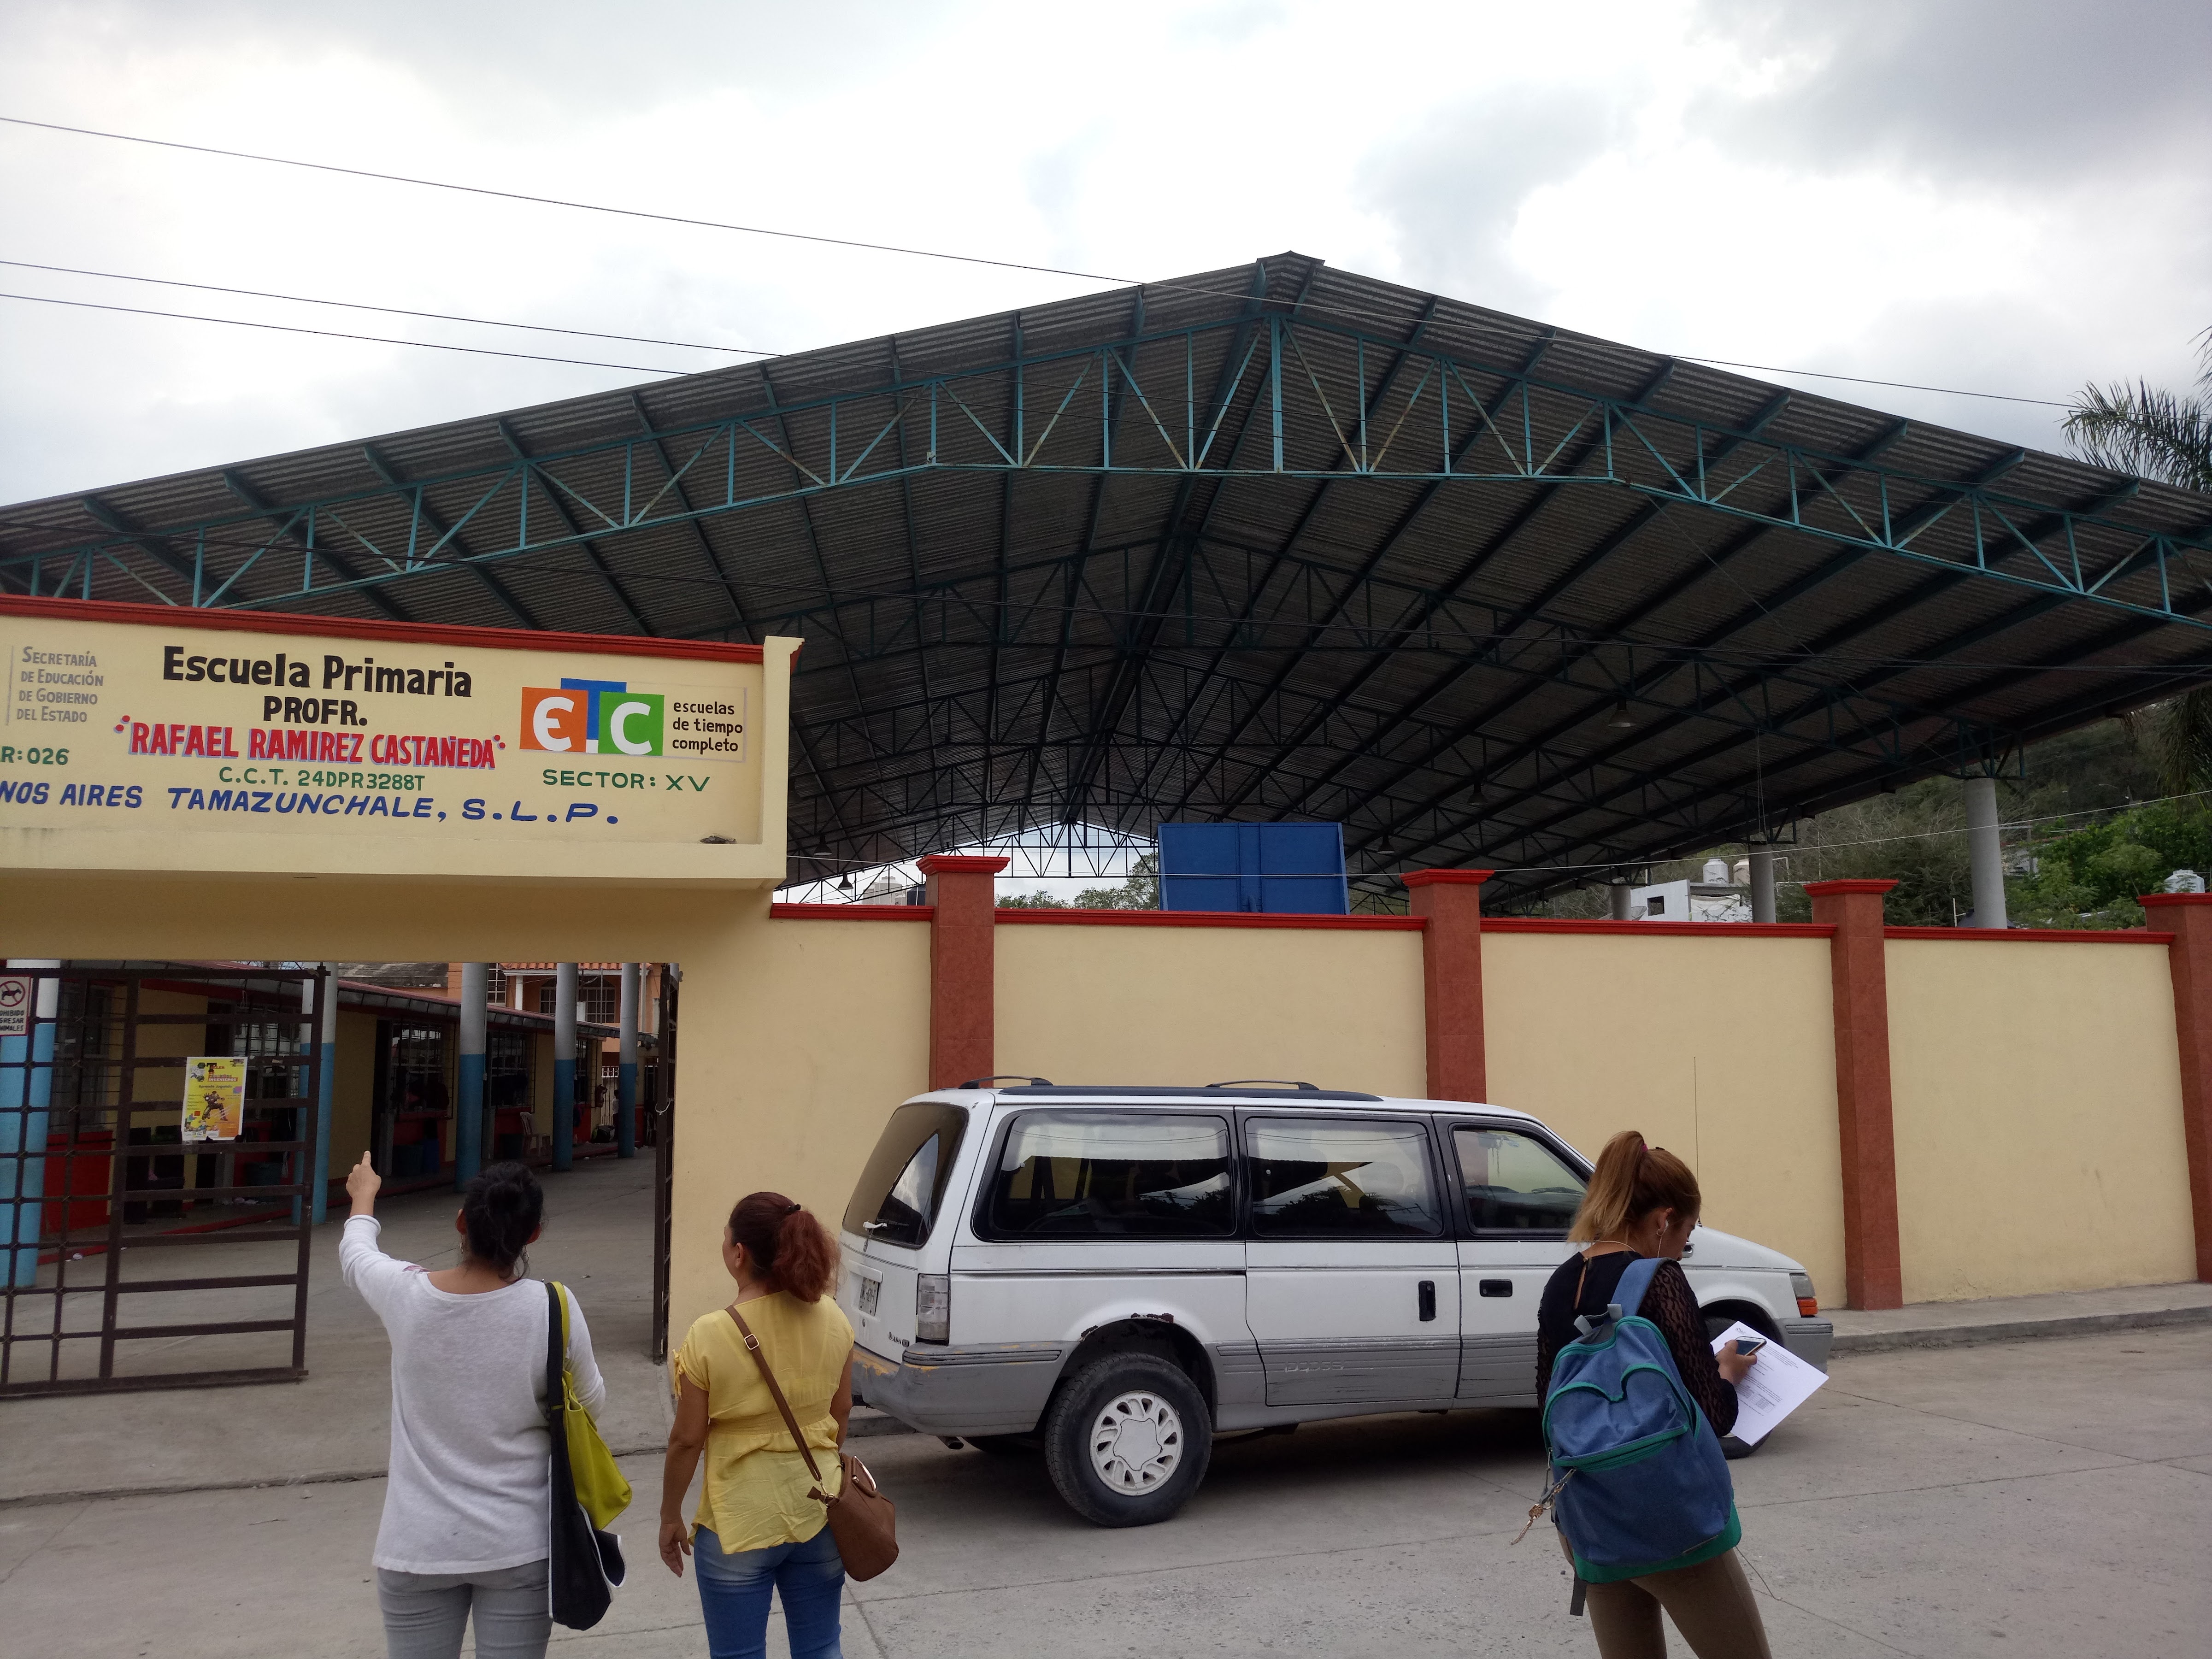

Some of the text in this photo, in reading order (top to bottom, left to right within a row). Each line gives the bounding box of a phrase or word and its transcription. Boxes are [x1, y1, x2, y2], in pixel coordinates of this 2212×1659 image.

[22, 647, 96, 667] SECRETARÍA
[21, 669, 103, 686] DE EDUCACIÓN
[164, 646, 471, 698] Escuela Primaria
[19, 688, 97, 705] DE GOBIERNO
[17, 706, 87, 722] DEL ESTADO
[264, 696, 367, 726] PROFR.
[673, 701, 735, 715] escuelas
[673, 717, 743, 734] de tiempo
[248, 728, 365, 763] RAMIREZ
[672, 737, 738, 754] completo
[1, 746, 70, 765] R:026
[219, 767, 425, 790] C.C.T. 24DPR3288T
[543, 769, 710, 791] SECTOR: XV
[0, 781, 618, 824] NOS AIRES TAMAZUNCHALE, S.L.P.
